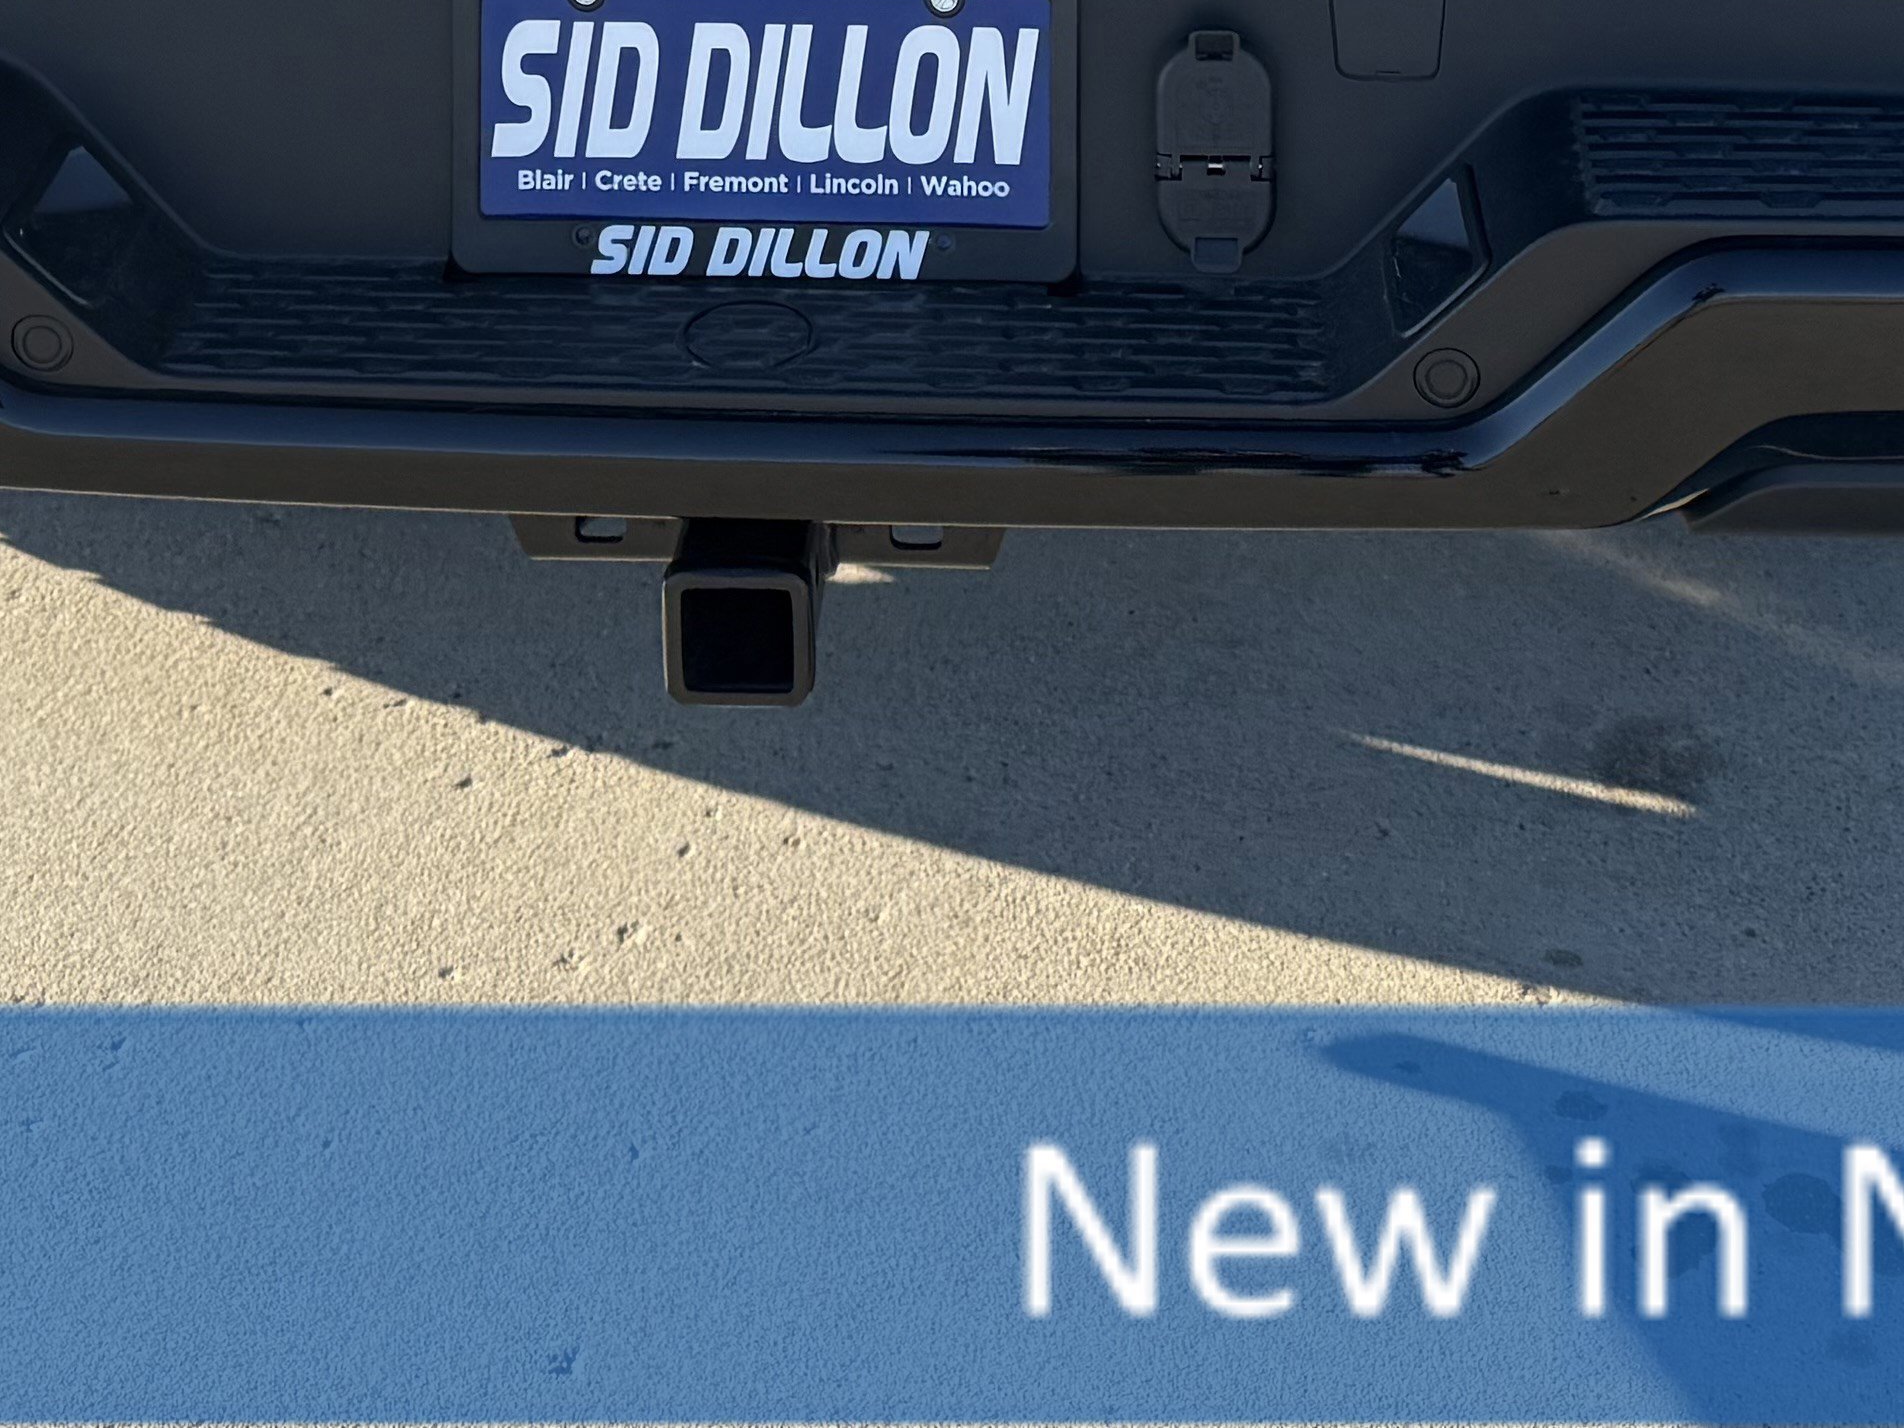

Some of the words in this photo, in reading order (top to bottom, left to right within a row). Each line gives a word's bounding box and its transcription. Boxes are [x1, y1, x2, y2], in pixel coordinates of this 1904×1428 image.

[491, 19, 659, 158] SID
[676, 22, 1039, 165] DILLON
[517, 169, 574, 191] Blair
[595, 170, 662, 192] Crete
[684, 171, 788, 194] Fremont
[810, 173, 899, 195] Lincoln
[921, 176, 1011, 198] Wahoo
[591, 224, 693, 276] SID
[706, 227, 930, 280] DILLON
